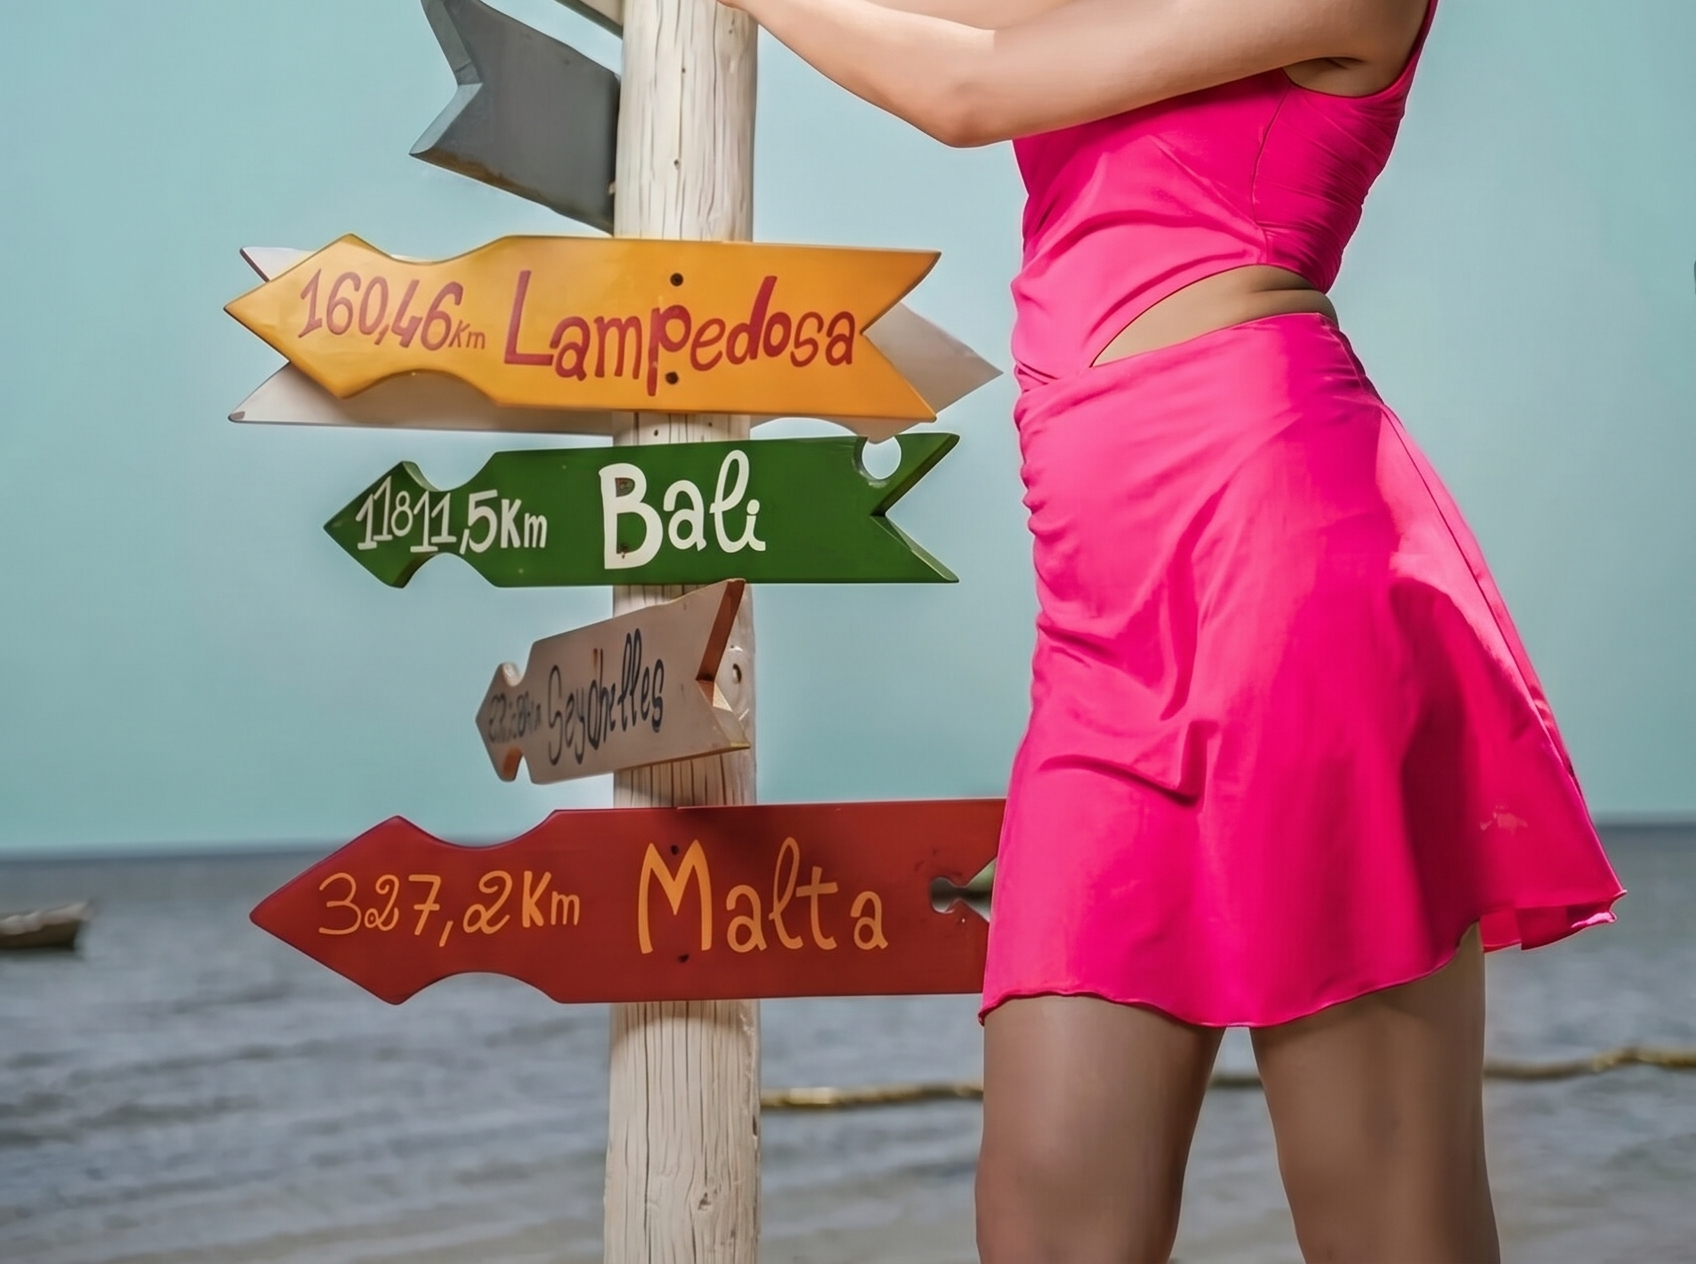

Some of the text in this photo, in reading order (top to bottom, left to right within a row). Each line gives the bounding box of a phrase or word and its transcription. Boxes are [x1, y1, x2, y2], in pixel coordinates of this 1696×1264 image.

[504, 270, 856, 397] Lampedosa
[599, 449, 766, 570] Bali
[637, 837, 889, 954] Malta
